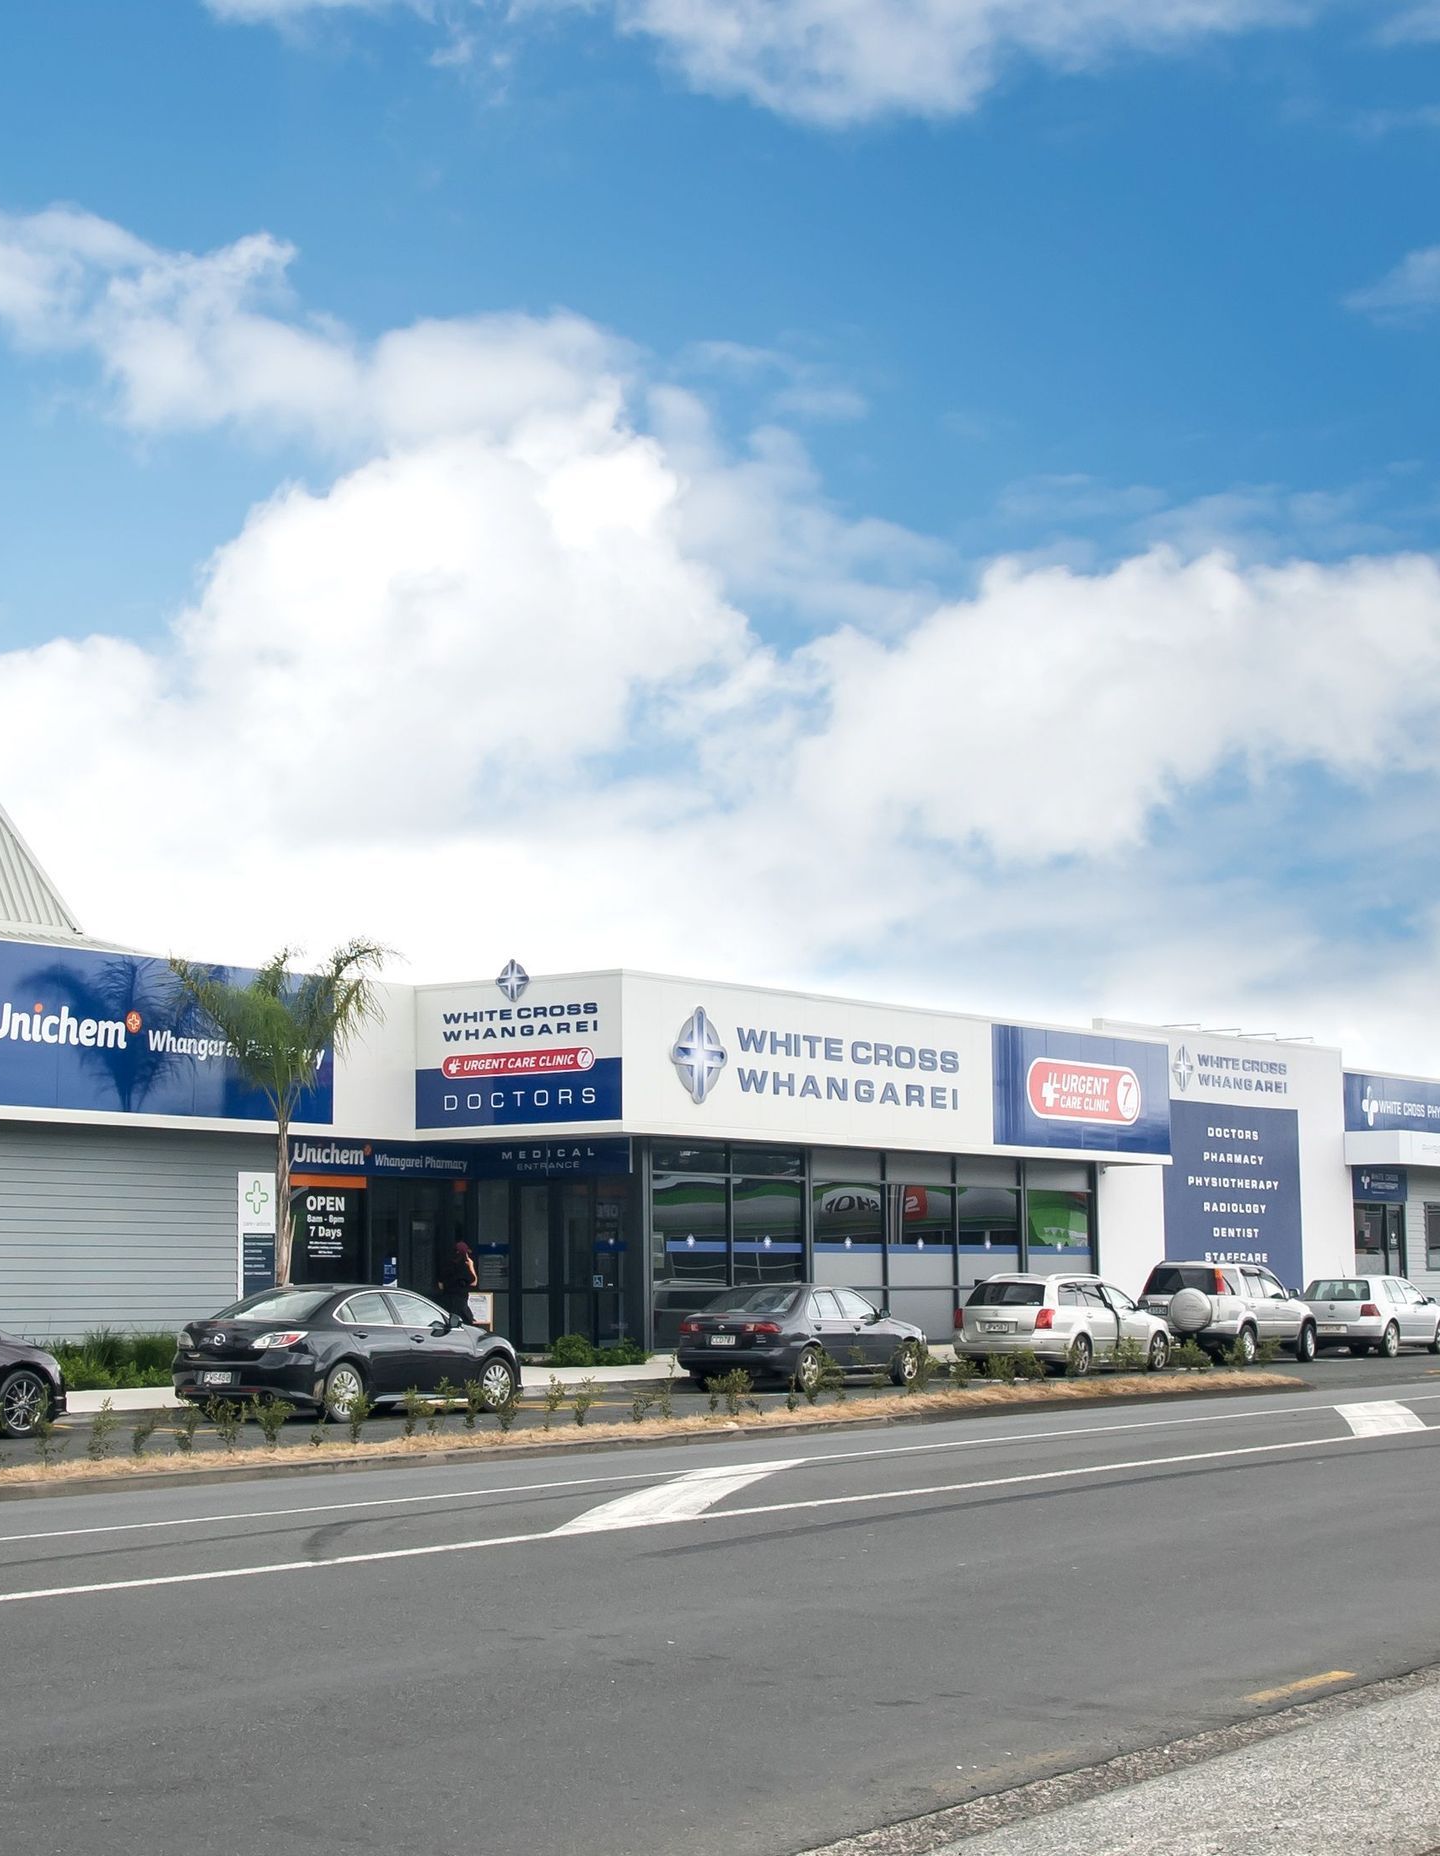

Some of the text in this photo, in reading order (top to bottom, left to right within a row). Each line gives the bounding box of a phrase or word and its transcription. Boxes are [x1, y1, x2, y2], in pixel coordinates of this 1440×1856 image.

[443, 1002, 598, 1024] WHITE CROSS
[443, 1020, 598, 1042] WHANGAREI
[581, 1051, 588, 1062] 7
[736, 1027, 959, 1074] WHITE CROSS
[463, 1054, 575, 1072] URGENT CARE CLINIC
[1197, 1054, 1287, 1075] WHITE CROSS
[736, 1067, 959, 1110] WHANGAREI
[1062, 1073, 1110, 1096] URGENT
[1197, 1073, 1288, 1094] WHANGAREI
[444, 1088, 596, 1111] DOCTORS
[1122, 1082, 1133, 1106] 7
[1060, 1095, 1111, 1113] CARE CLINIC
[1379, 1100, 1402, 1115] WHITE
[1403, 1102, 1426, 1118] CROSS
[1207, 1127, 1259, 1141] DOCTORS
[294, 1142, 468, 1174] Unichem Whangarei Pharmacy
[501, 1147, 595, 1161] MEDICAL
[1203, 1152, 1264, 1165] PHARMACY
[517, 1160, 580, 1172] ENTRANCE
[1188, 1176, 1279, 1191] PHYSIOTHERAPY
[306, 1196, 345, 1212] OPEN
[1203, 1202, 1267, 1214] RADIOLOGY
[307, 1214, 323, 1223] 8am
[309, 1226, 342, 1240] 7 Days
[1213, 1227, 1260, 1239] DENTIST
